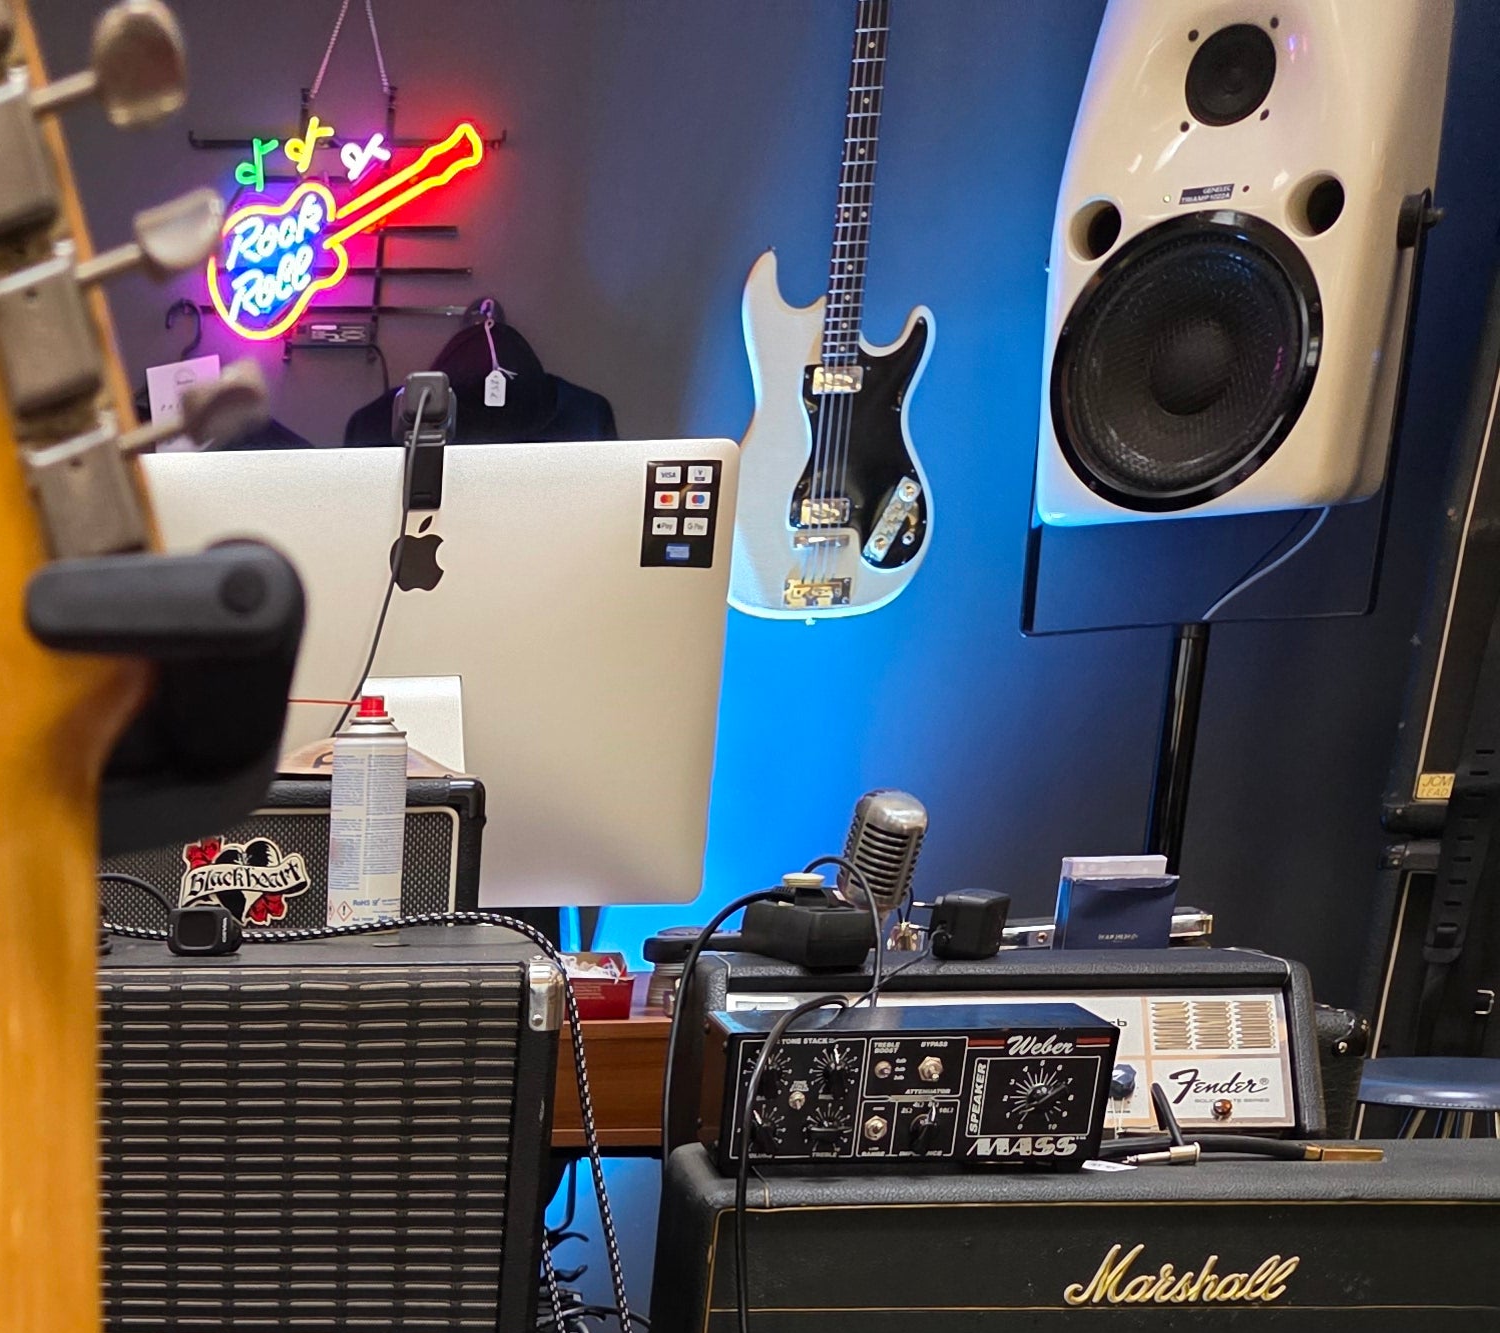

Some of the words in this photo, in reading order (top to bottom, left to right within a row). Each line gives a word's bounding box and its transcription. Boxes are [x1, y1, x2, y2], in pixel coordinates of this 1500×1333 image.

[1202, 185, 1232, 194] GENELEC
[225, 193, 323, 271] Rock
[228, 244, 314, 322] Roll
[660, 471, 677, 479] VISA
[1422, 775, 1454, 787] JCM
[190, 862, 302, 897] Blackheart
[1007, 1034, 1074, 1055] Weber
[969, 1062, 987, 1134] SPEAKER
[1169, 1068, 1268, 1104] Fender
[967, 1137, 1078, 1156] MASS
[1063, 1243, 1300, 1304] Marshall
